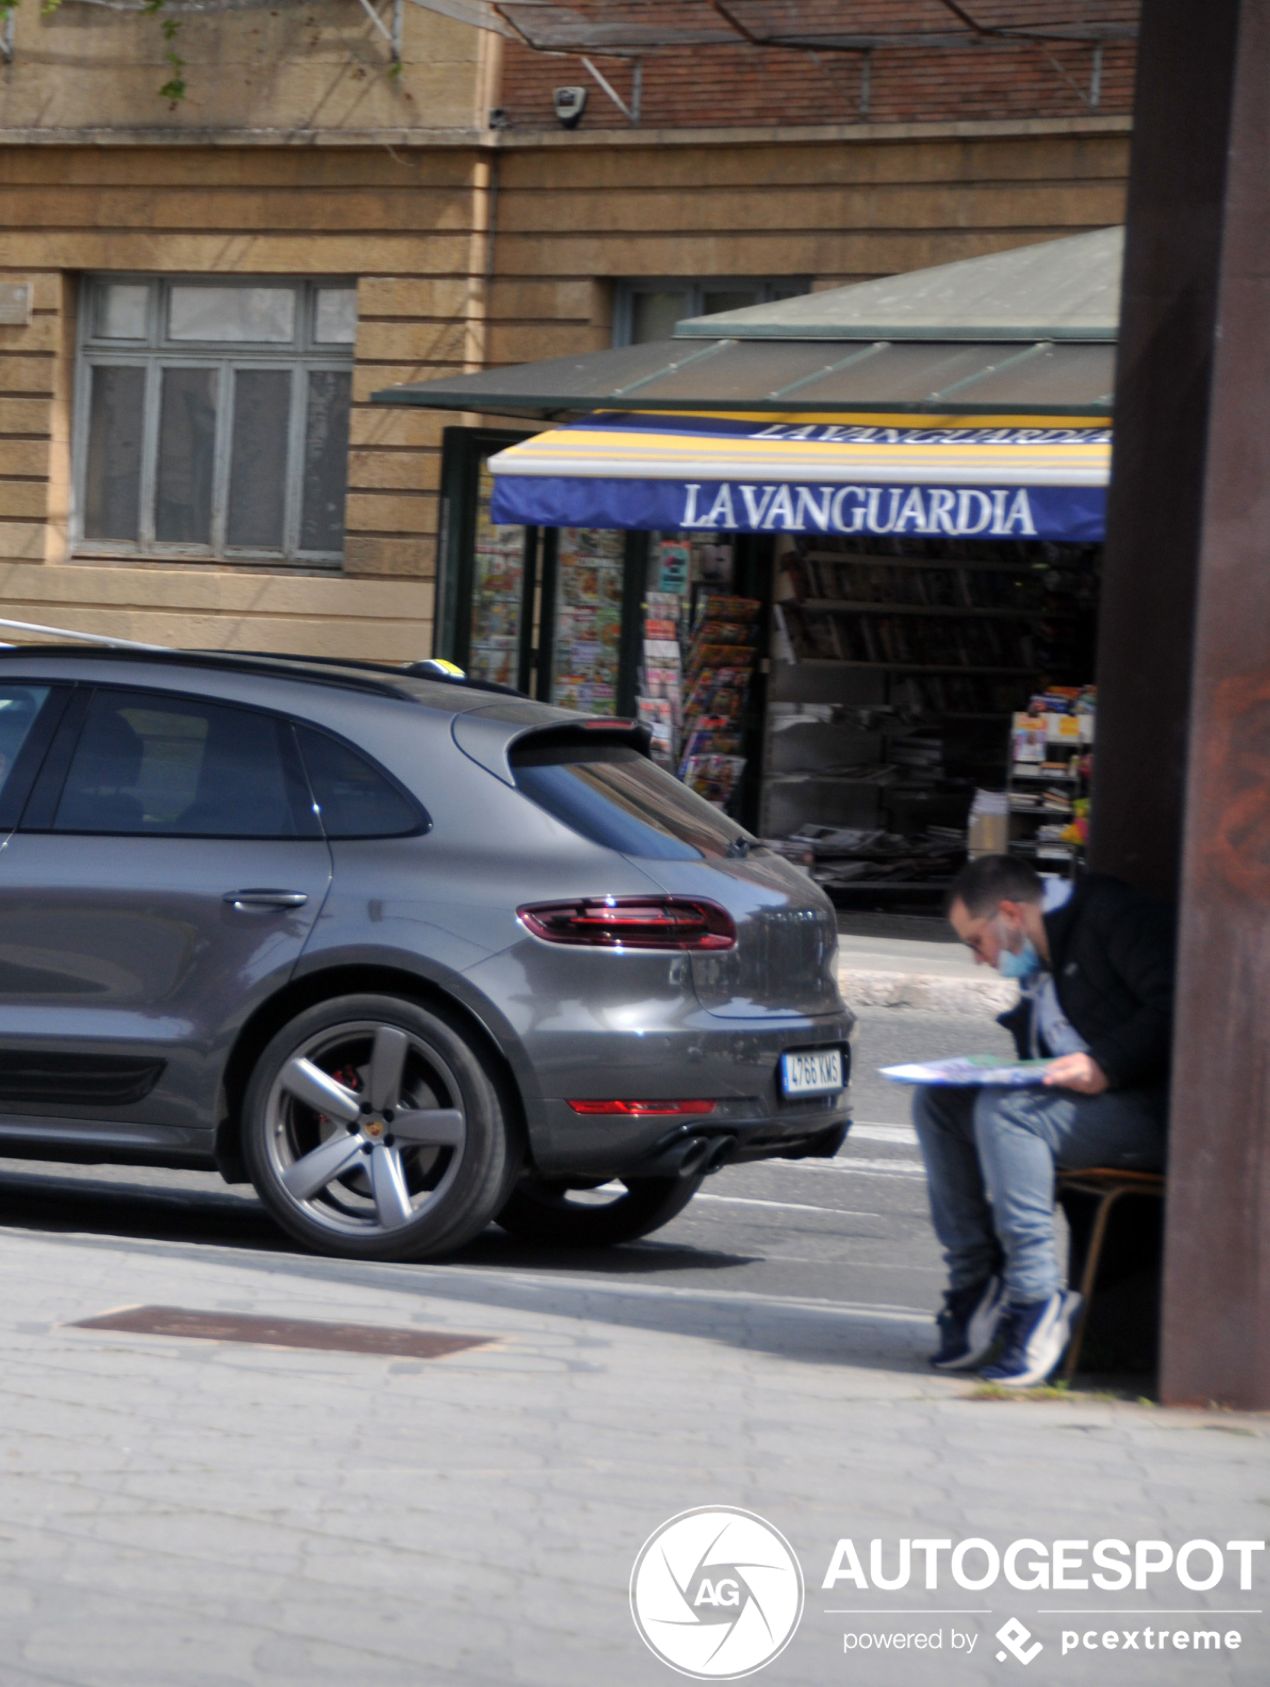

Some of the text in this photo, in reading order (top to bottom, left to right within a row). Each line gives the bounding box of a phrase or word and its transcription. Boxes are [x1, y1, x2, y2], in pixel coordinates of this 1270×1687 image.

[680, 483, 1038, 536] LA VANGUARDIA
[791, 1055, 818, 1087] 4766
